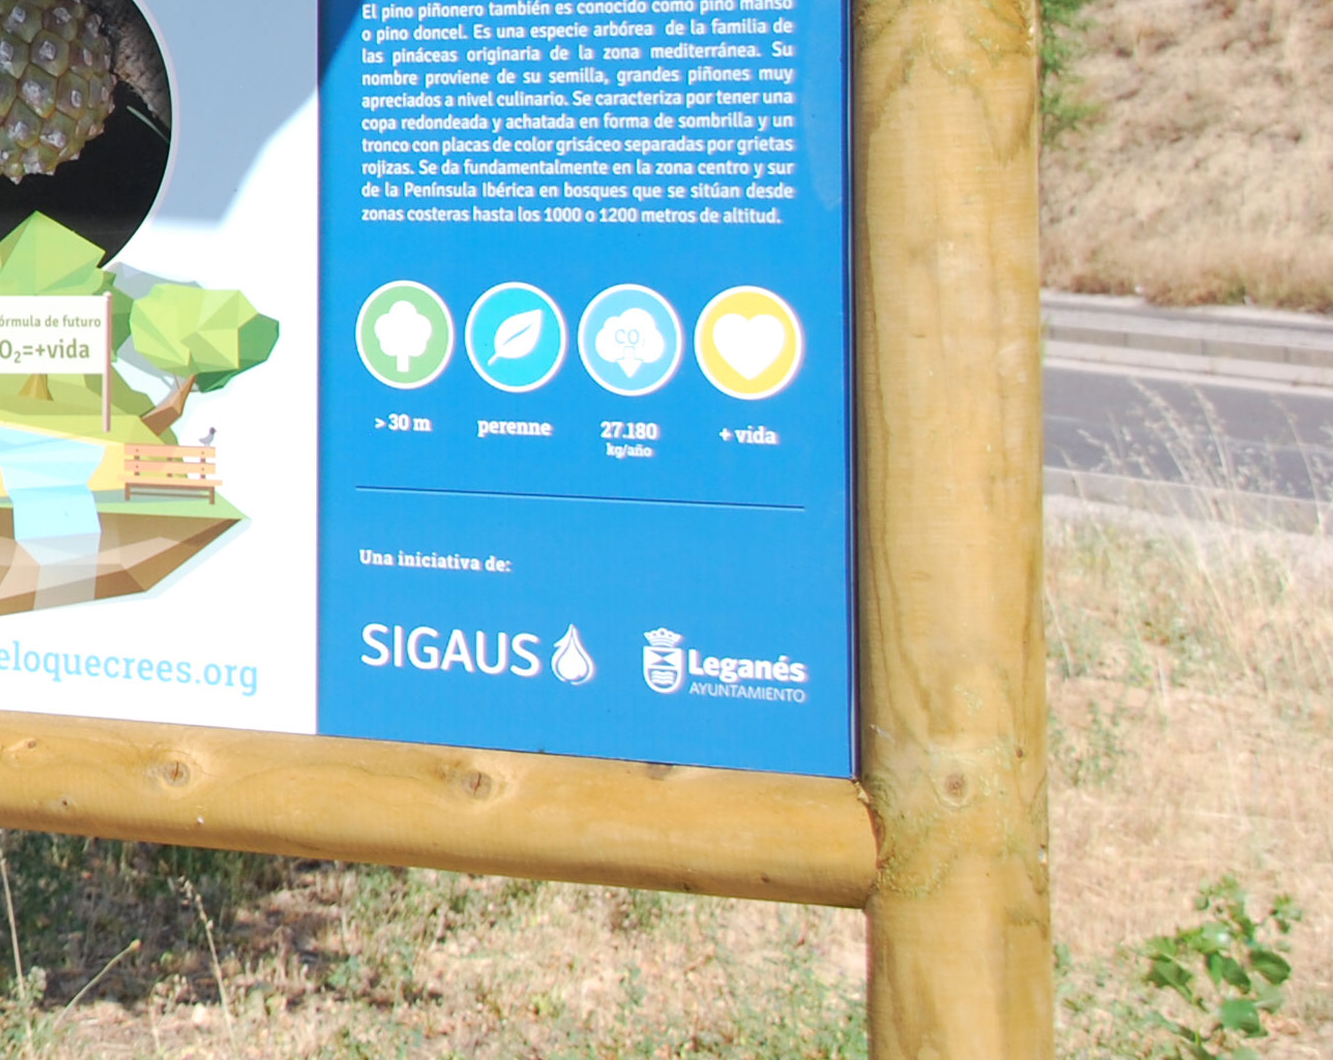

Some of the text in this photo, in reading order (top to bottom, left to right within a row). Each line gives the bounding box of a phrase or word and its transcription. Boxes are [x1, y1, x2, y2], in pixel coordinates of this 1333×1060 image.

[362, 3, 378, 20] El
[381, 3, 415, 23] pino
[418, 2, 486, 21] piñonero
[488, 0, 551, 16] también
[554, 2, 573, 15] es
[651, 0, 697, 12] como
[361, 41, 796, 67] las pináceas originaria de la zona mediterránea. Su
[362, 65, 795, 88] nombre proviene de su semilla, grandes piñones muy
[361, 136, 797, 156] tronco con placas de color grisáceo separadas por grietas
[361, 181, 797, 202] de la Península Ibérica en bosques que se sitúan desde
[44, 315, 59, 328] de
[62, 315, 102, 328] futuro
[388, 413, 411, 431] 30
[413, 417, 432, 432] m
[477, 419, 553, 438] perenne
[600, 421, 659, 440] 27.180
[734, 425, 779, 445] vida
[606, 442, 654, 459] kg/año
[359, 549, 512, 572] Una iniciativa de:
[361, 623, 541, 677] SIGAUS
[688, 648, 808, 683] Leganés
[689, 682, 807, 703] AYUNTAMIENTO
